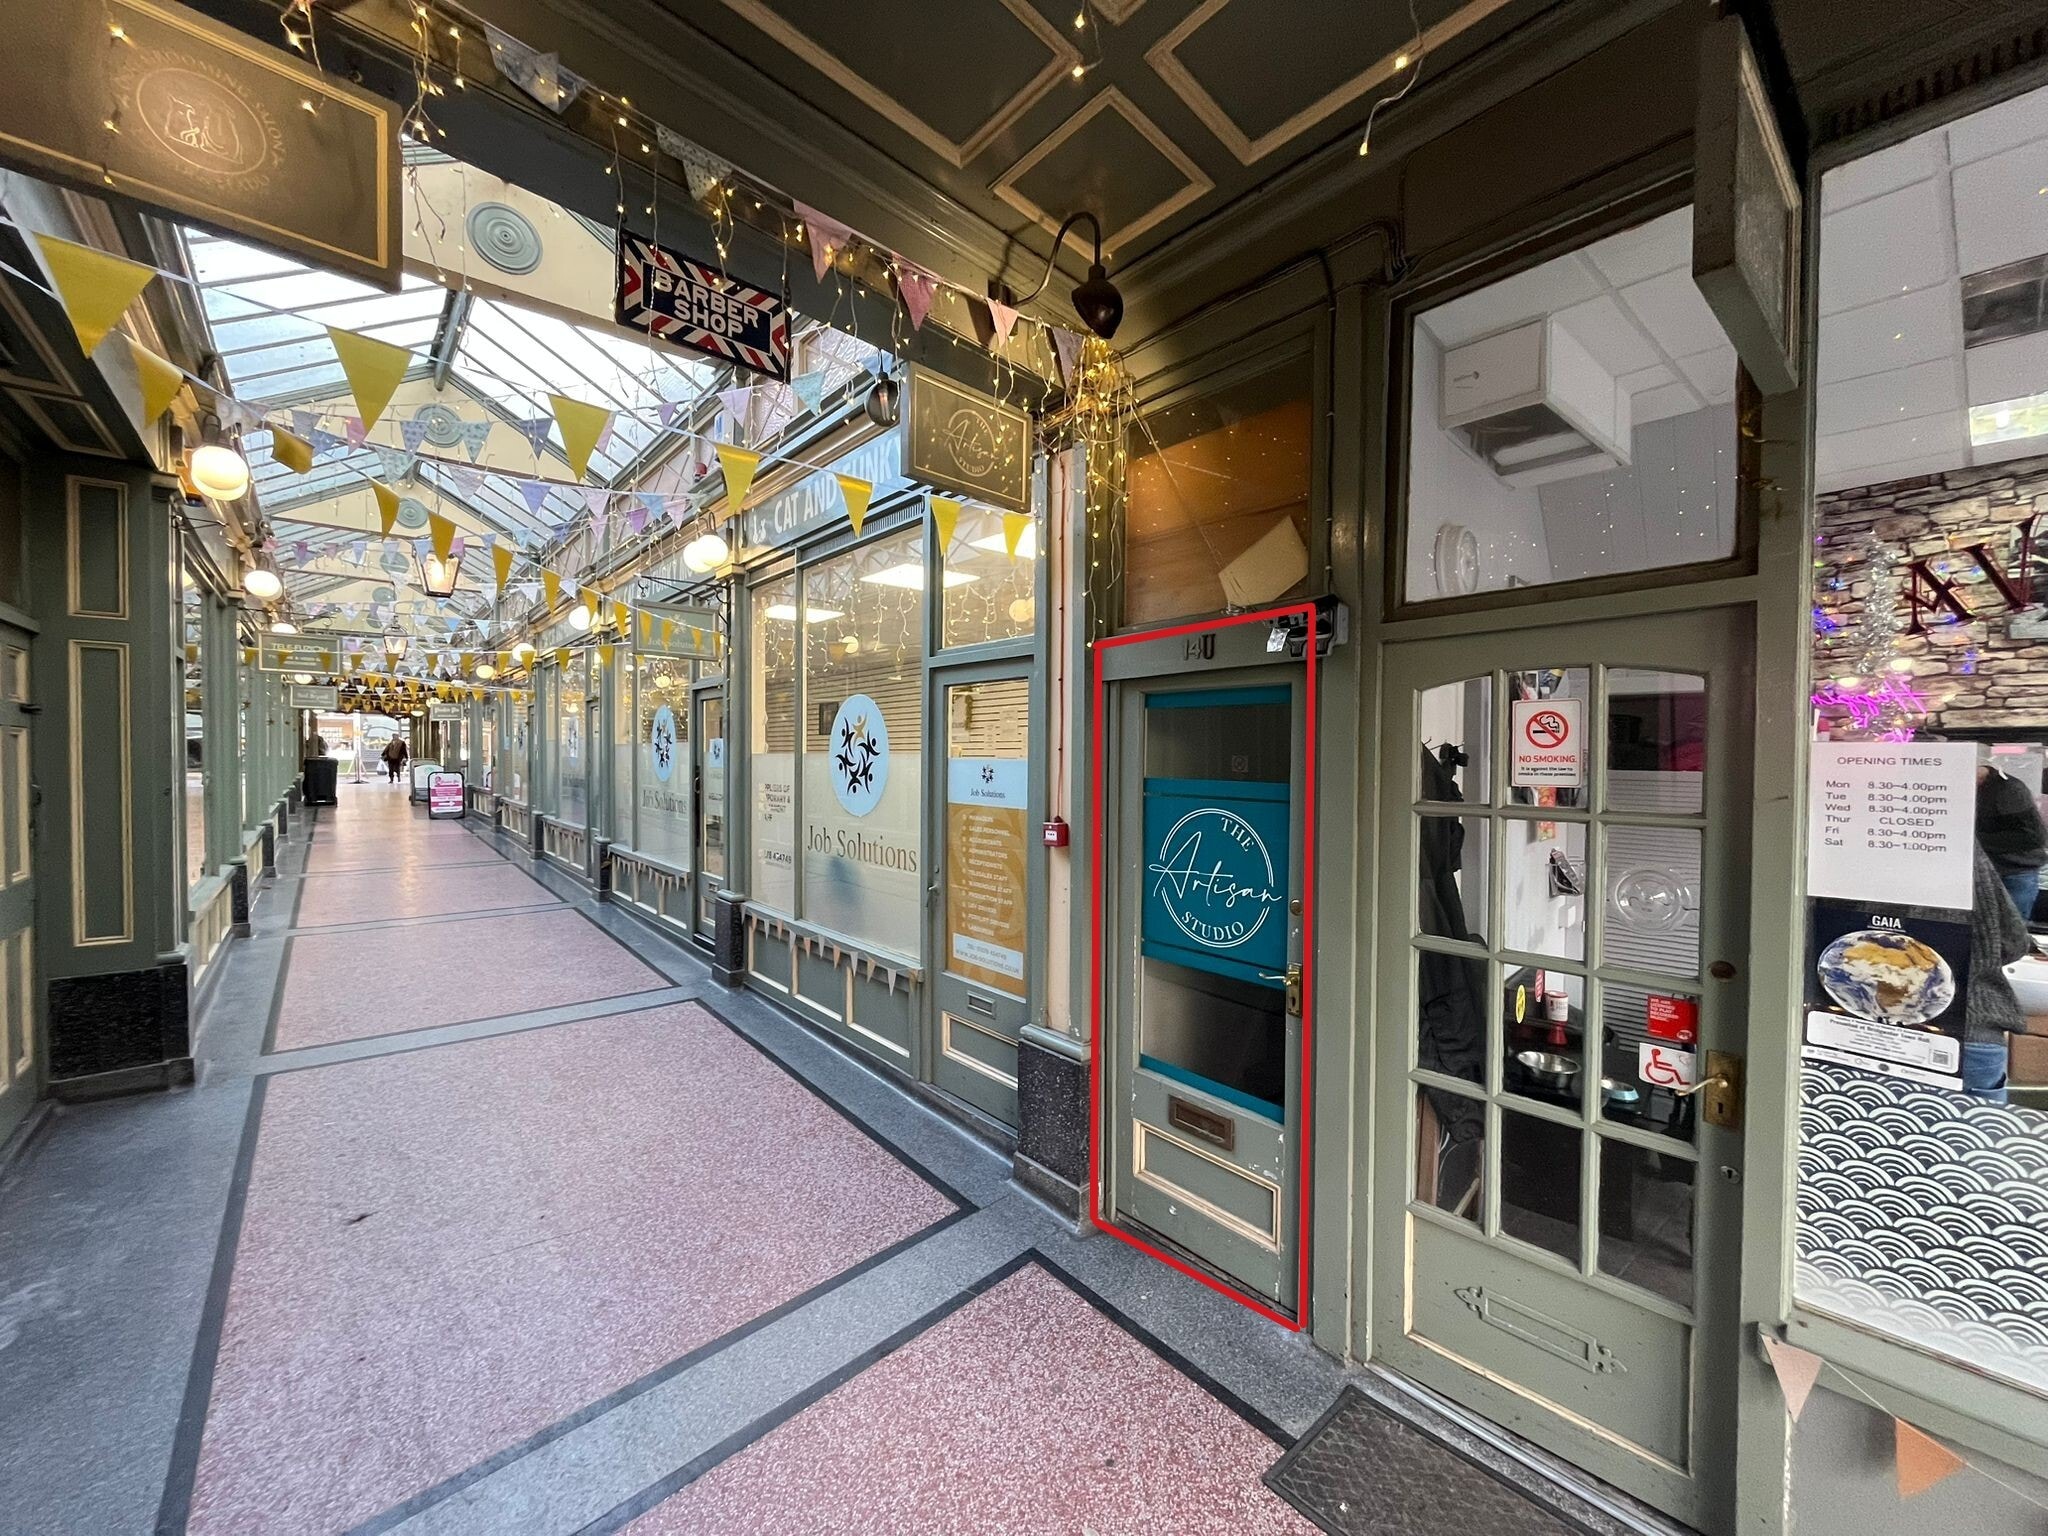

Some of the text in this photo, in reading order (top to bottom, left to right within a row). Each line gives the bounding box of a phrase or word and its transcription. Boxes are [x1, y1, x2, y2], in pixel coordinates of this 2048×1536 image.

[655, 269, 759, 329] BARBER
[674, 299, 744, 338] SHOP
[941, 419, 999, 459] Artisan
[960, 456, 985, 472] STUDIO
[774, 493, 799, 534] CAT
[803, 475, 838, 522] AND
[1184, 633, 1216, 661] 14U
[1519, 755, 1531, 763] NO
[1837, 756, 1942, 766] OPENING TIMES
[1826, 780, 1850, 788] Mon
[971, 788, 1005, 798] Job Solutions
[1826, 792, 1847, 800] Tue
[1825, 803, 1851, 812] Wed
[1826, 815, 1935, 827] Thur CLOSED
[1221, 817, 1254, 852] THE
[1825, 826, 1839, 834] Fri
[807, 825, 917, 873] Job Solutions
[1825, 838, 1843, 846] Sat
[1149, 831, 1283, 908] Artisan
[1181, 911, 1244, 941] STUDIO
[1872, 915, 1901, 928] GAIA
